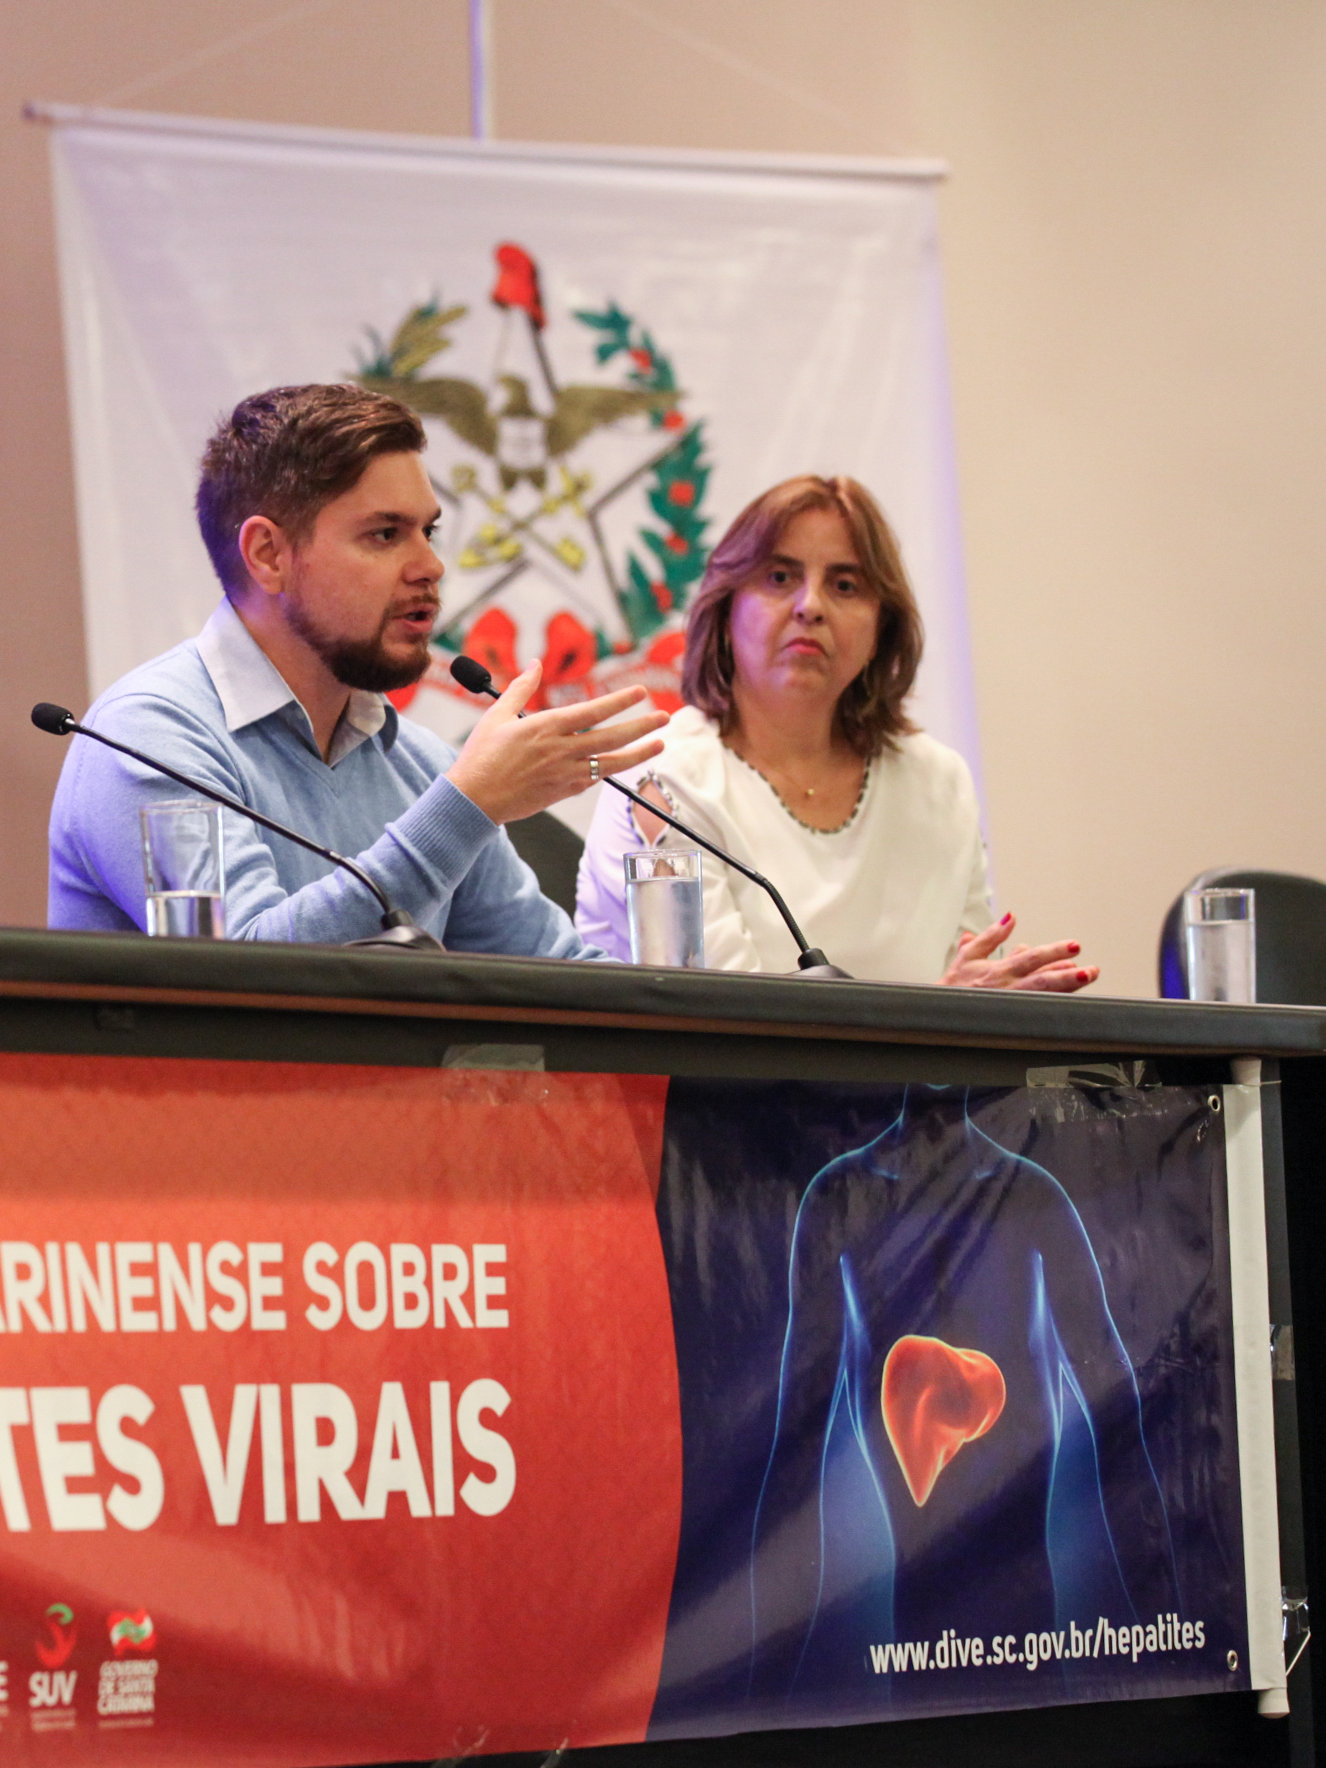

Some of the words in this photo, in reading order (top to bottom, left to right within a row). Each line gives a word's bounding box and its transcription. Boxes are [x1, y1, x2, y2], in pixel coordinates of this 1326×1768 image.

[303, 1240, 510, 1331] SOBRE
[180, 1377, 517, 1526] VIRAIS
[869, 1613, 1205, 1674] www.dive.sc.gov.br/hepatites
[29, 1670, 78, 1707] SUV
